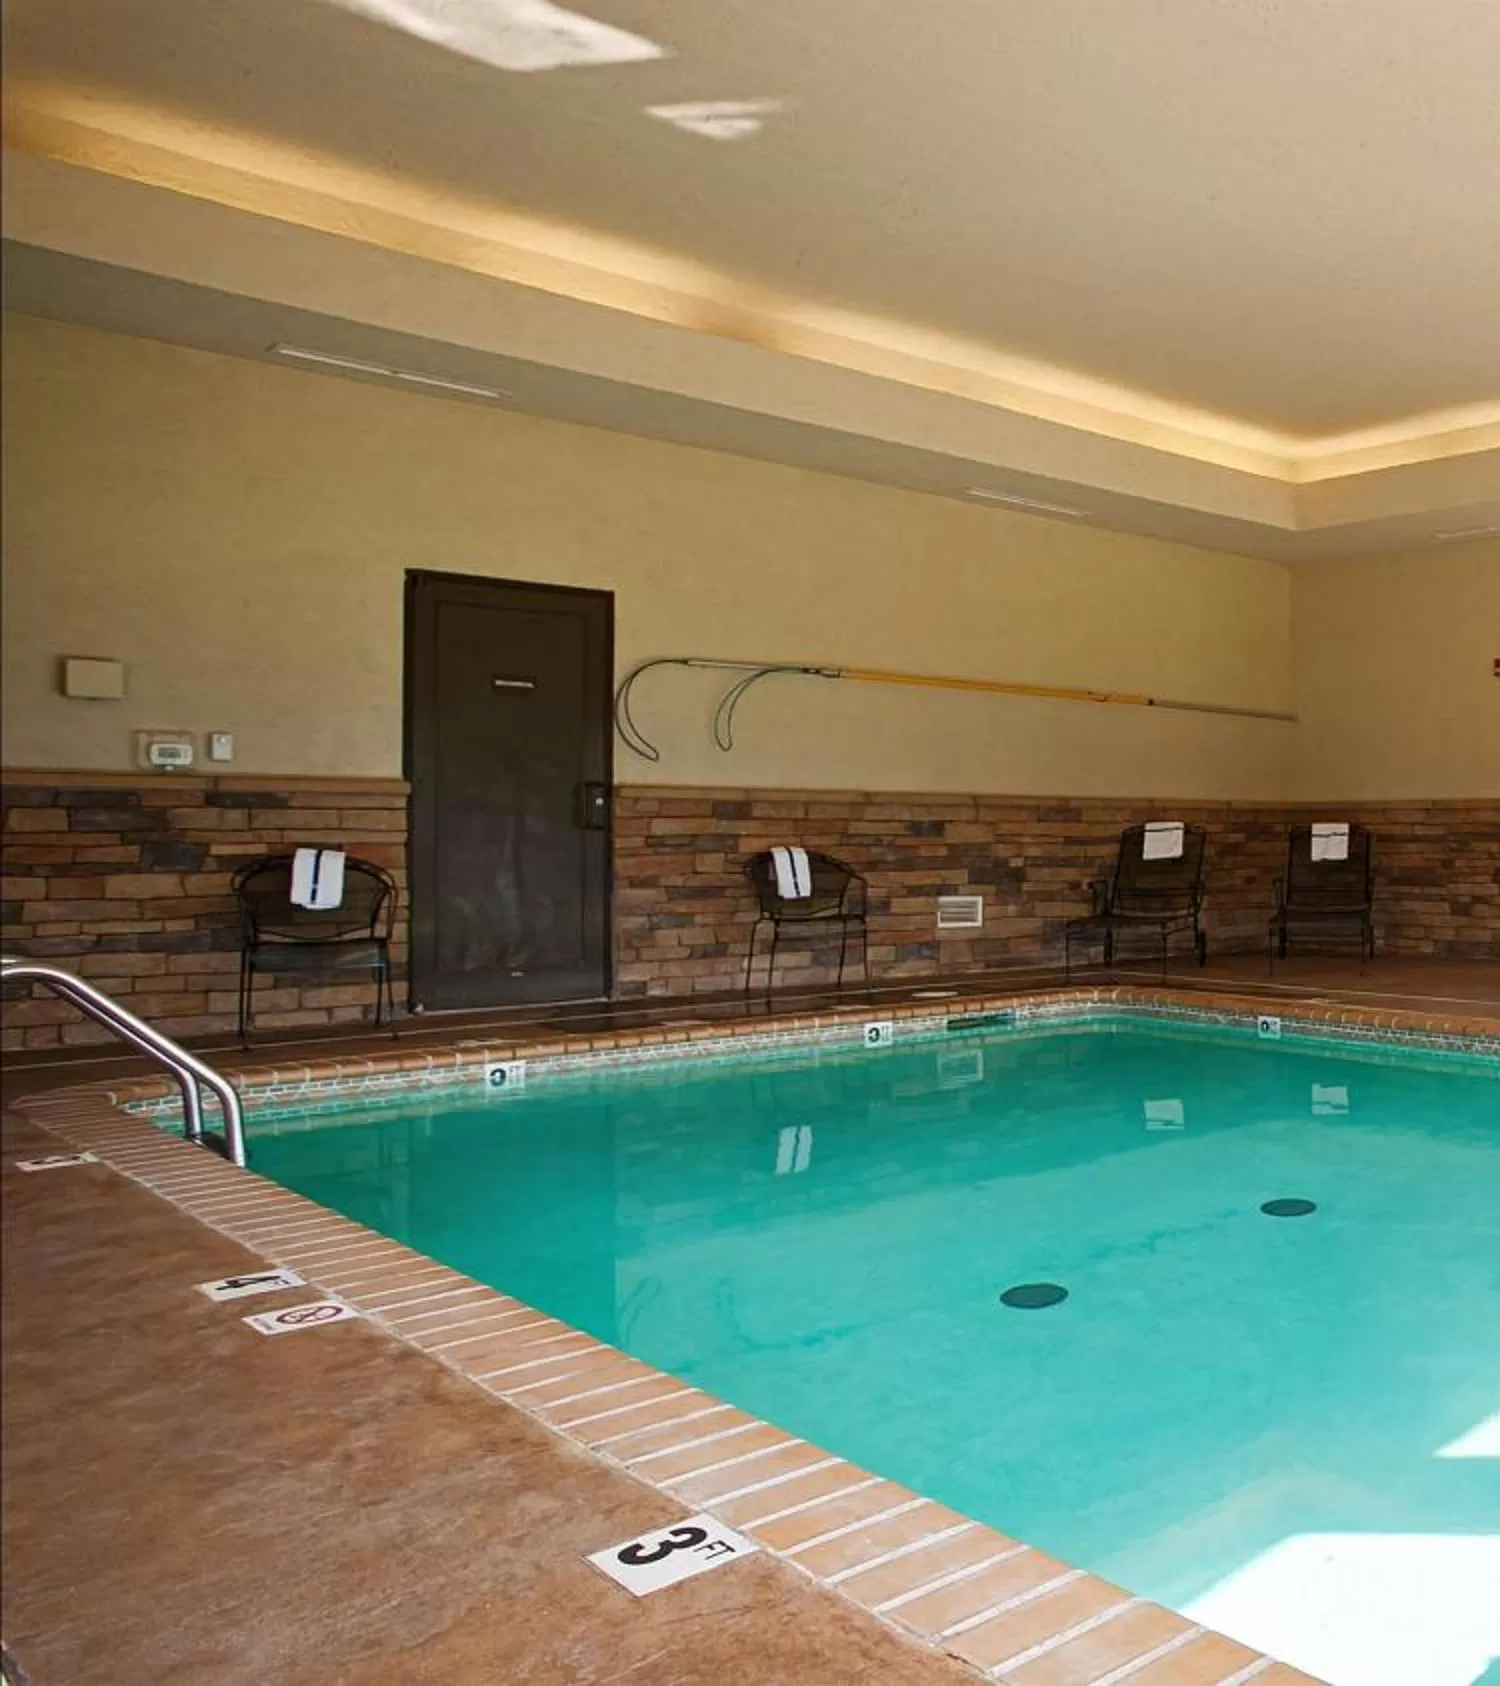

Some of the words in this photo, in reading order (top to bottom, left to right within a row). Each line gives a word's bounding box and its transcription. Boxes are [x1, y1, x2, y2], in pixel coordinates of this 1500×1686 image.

[867, 1027, 881, 1043] 3
[617, 1526, 708, 1566] 3
[693, 1539, 737, 1561] FT
